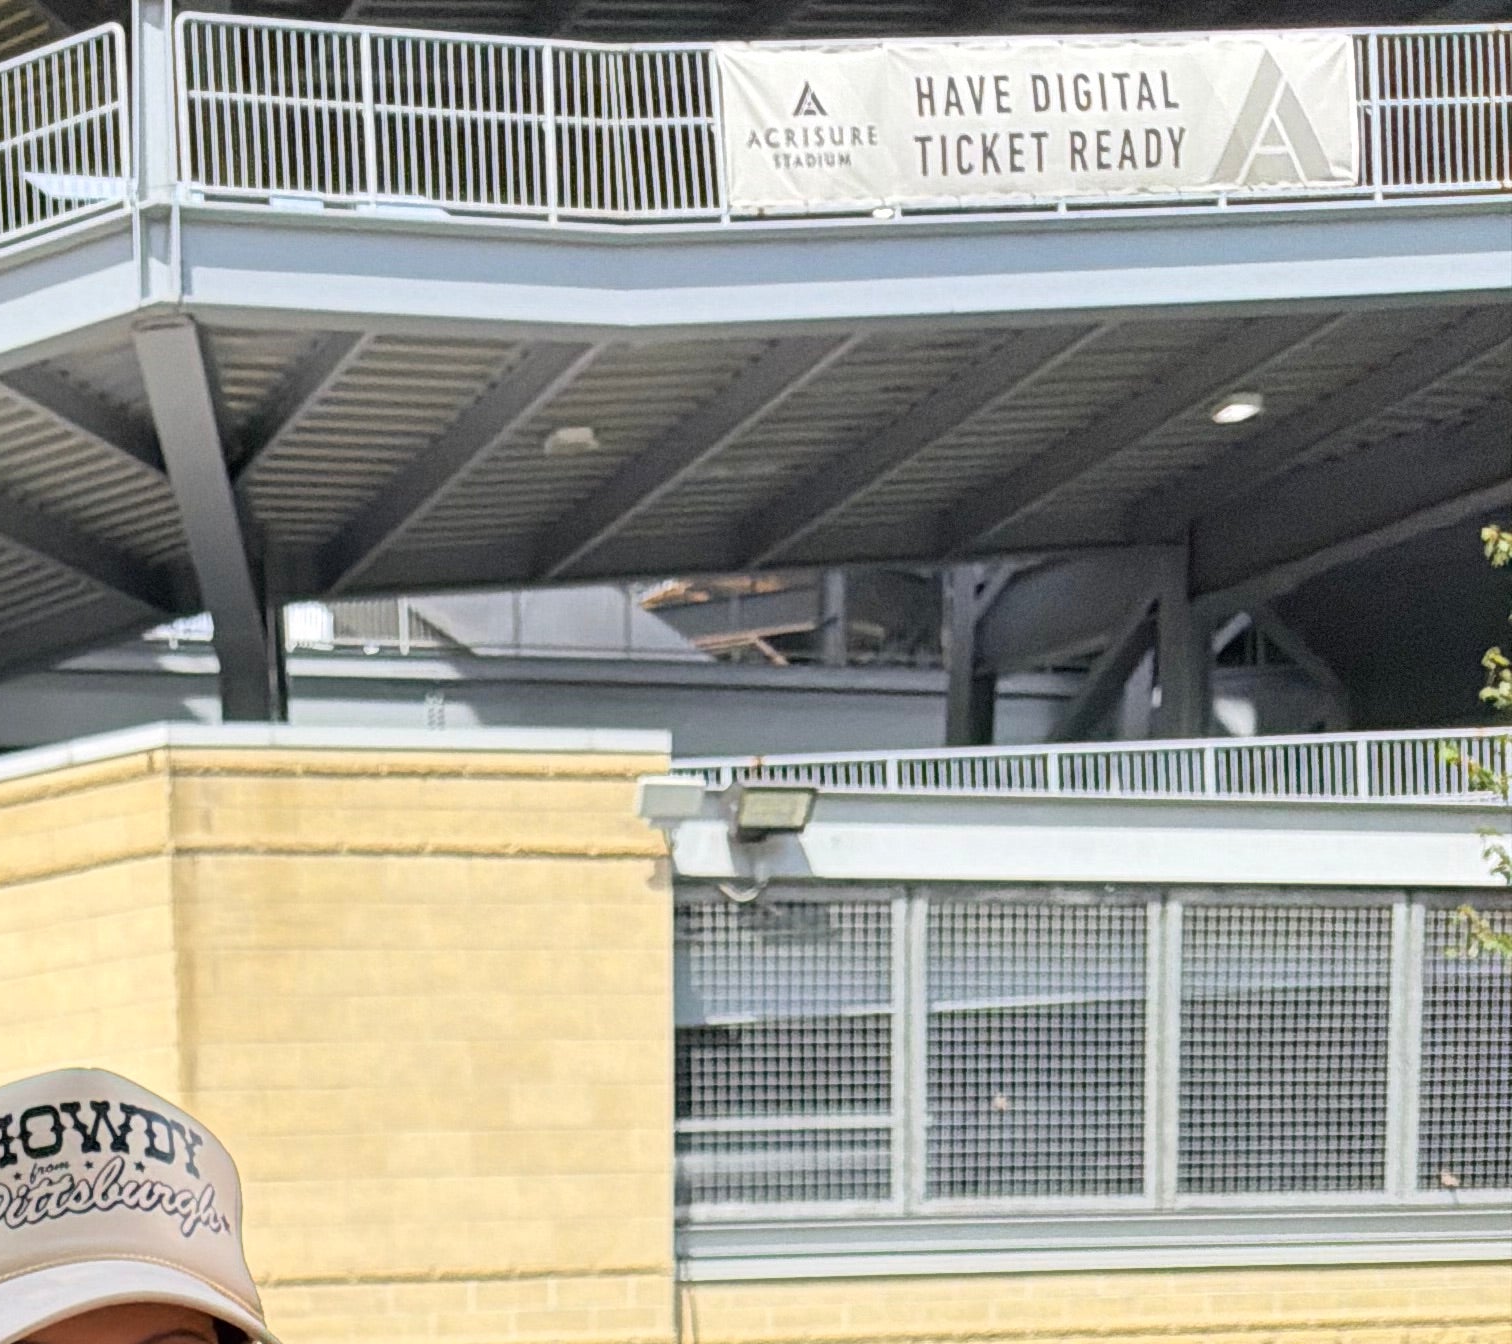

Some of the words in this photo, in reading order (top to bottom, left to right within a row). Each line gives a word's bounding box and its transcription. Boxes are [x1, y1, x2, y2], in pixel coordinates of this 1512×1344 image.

[915, 73, 1014, 117] HAVE
[1031, 70, 1180, 113] DIGITAL
[746, 125, 879, 149] ACRISURE
[773, 152, 852, 169] STADIUM
[914, 131, 1049, 177] TICKET
[1069, 126, 1187, 172] READY
[29, 1160, 70, 1184] from
